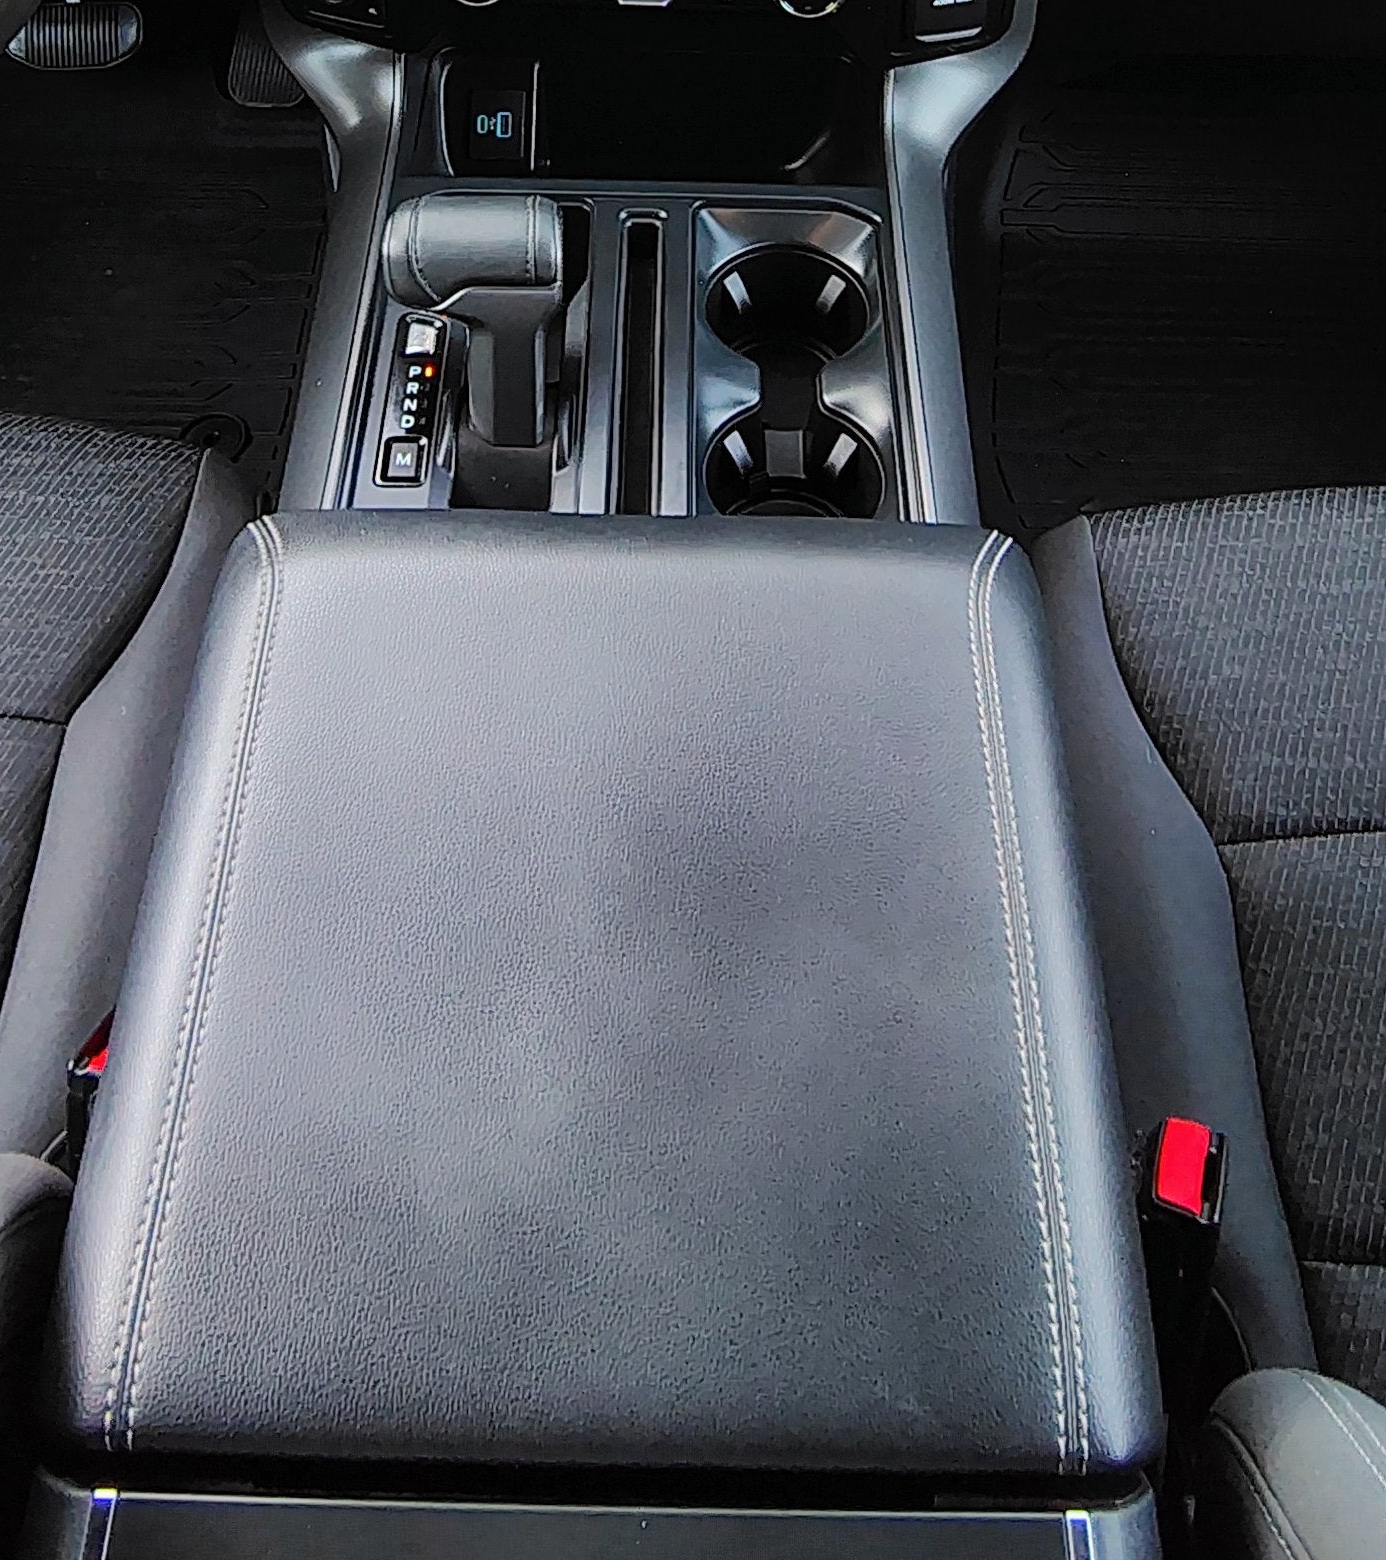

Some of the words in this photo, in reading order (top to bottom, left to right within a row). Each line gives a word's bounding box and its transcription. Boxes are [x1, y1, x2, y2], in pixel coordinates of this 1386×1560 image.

[408, 365, 422, 378] P
[406, 381, 419, 395] R
[403, 398, 417, 411] N
[401, 414, 415, 428] D
[395, 452, 411, 466] M
